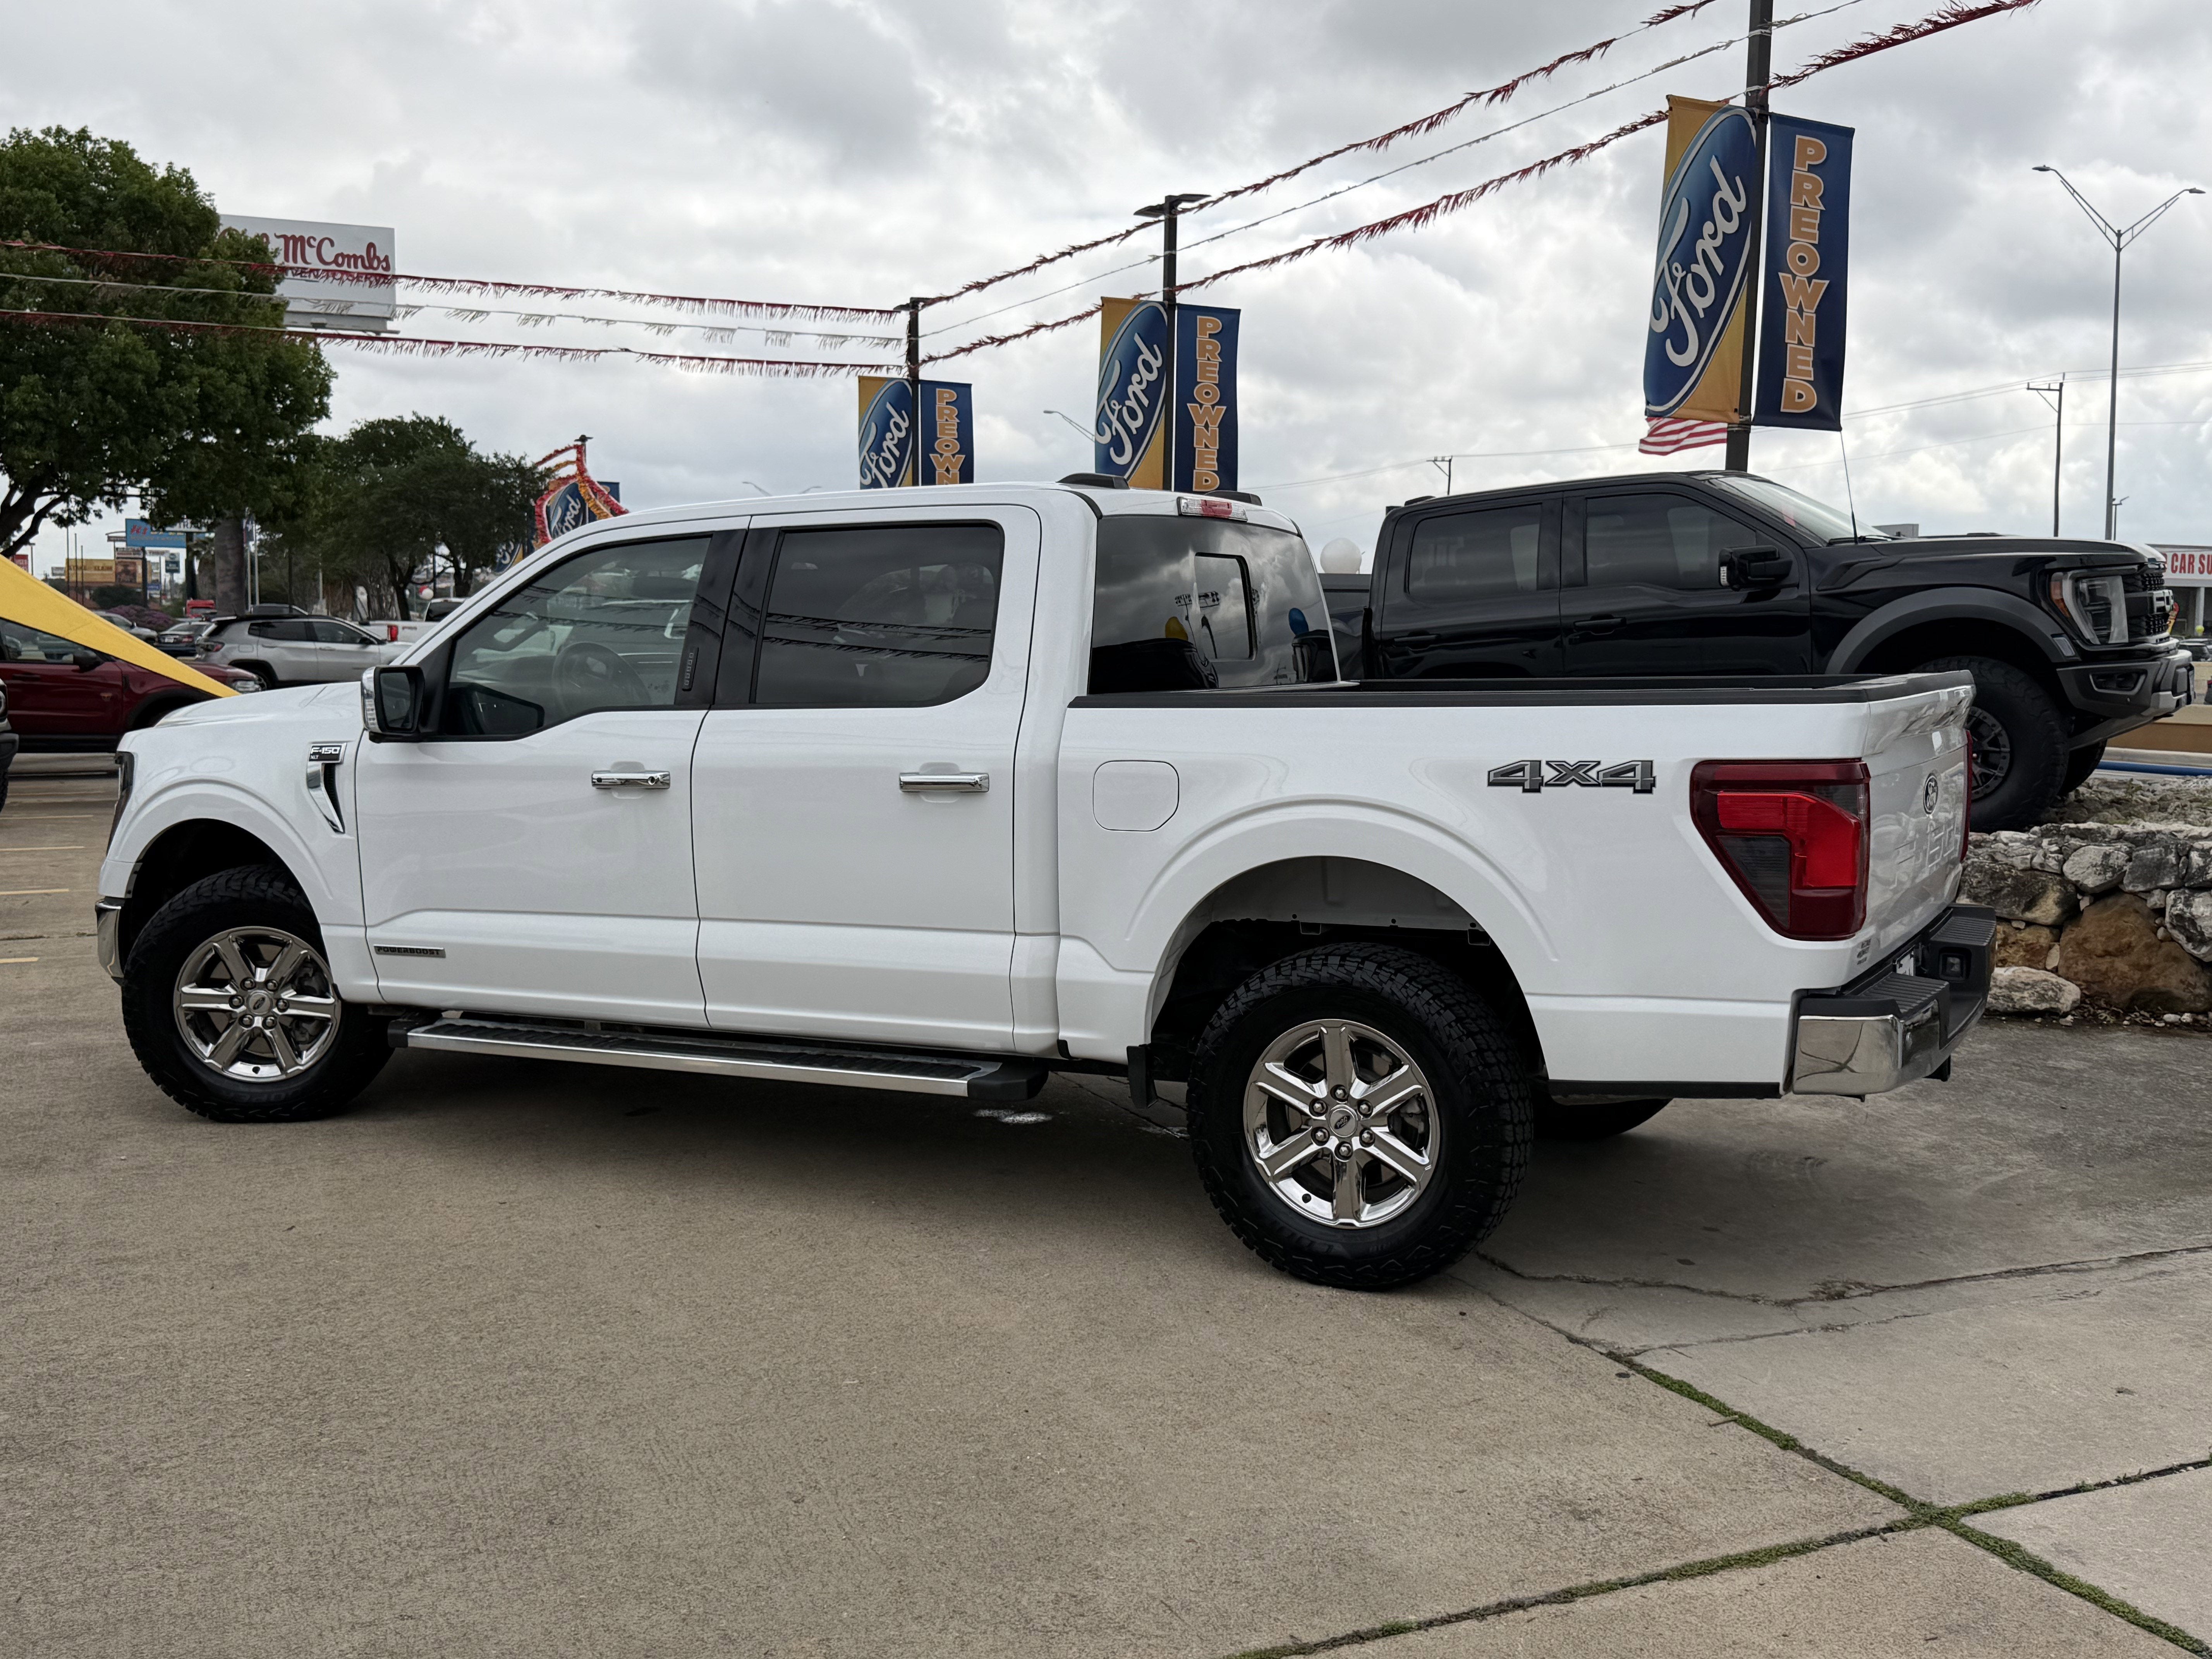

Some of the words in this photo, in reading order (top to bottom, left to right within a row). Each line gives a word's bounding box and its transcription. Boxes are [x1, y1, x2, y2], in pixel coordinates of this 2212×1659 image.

[274, 232, 391, 271] McCombs
[1650, 155, 1747, 367] Ford
[1778, 135, 1829, 413] PREOWNED
[860, 402, 909, 488] Ford
[1095, 332, 1163, 465] Ford
[1187, 316, 1226, 491] PREOWNED
[2171, 553, 2195, 574] CAR
[377, 946, 440, 955] POWERBOOST
